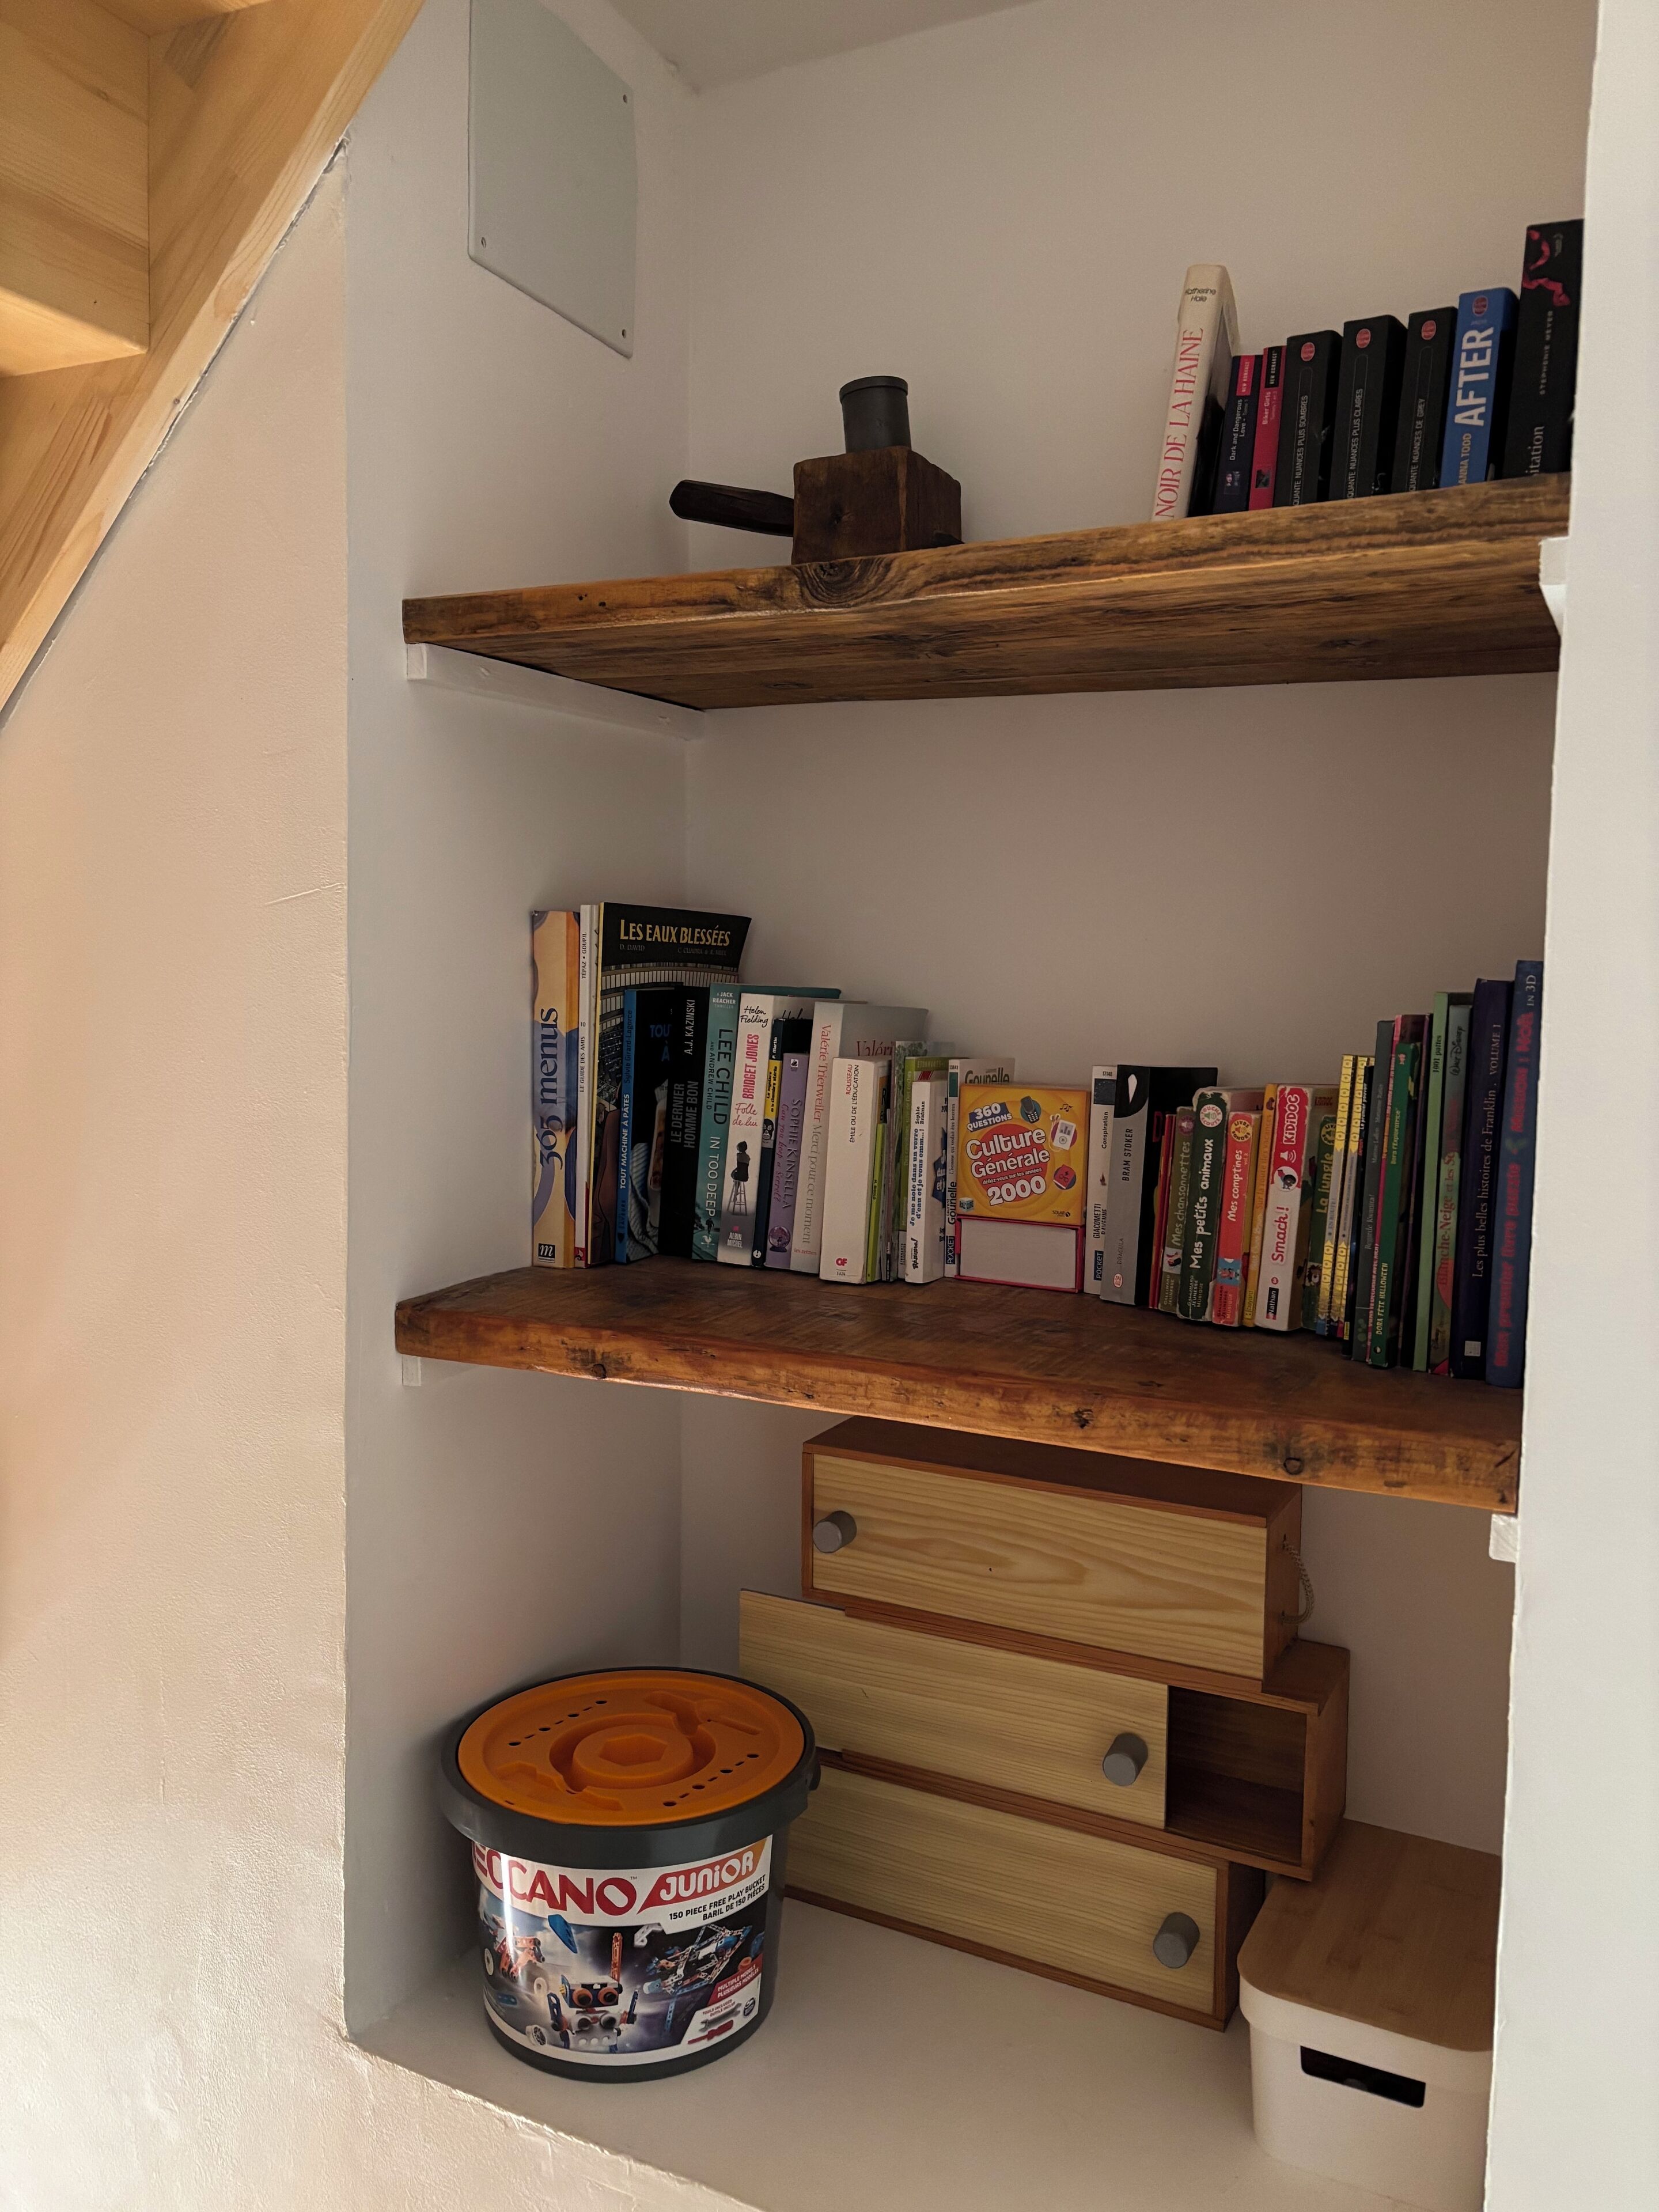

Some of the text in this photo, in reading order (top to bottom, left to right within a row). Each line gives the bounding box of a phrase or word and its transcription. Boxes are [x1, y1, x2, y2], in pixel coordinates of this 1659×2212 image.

[1454, 326, 1494, 427] AFTER
[1233, 399, 1243, 432] Dangerous
[1354, 388, 1363, 418] CLAIRES
[1154, 327, 1204, 519] NOIR DE LA HAINE
[1294, 446, 1304, 478] NUANCES
[1299, 395, 1309, 426] SOMBRES
[1353, 418, 1361, 436] PLUS
[1349, 436, 1359, 469] NUANCES
[1458, 432, 1471, 485] ANNA TODD
[619, 918, 732, 948] LES EAUX BLESSÉES
[712, 997, 736, 1005] REACHER
[1525, 974, 1537, 1007] EN 3D
[683, 999, 695, 1055] A.J. KAZINSKI
[740, 1014, 769, 1028] Fielding
[744, 1005, 767, 1016] Helen
[708, 1053, 716, 1085] ANDREW
[713, 1029, 733, 1125] LEE CHILD
[742, 1033, 760, 1100] BRIDGET JONES
[813, 1024, 831, 1122] Valérie Trierweiler
[536, 1007, 563, 1171] 365 menus
[706, 1088, 714, 1110] CHILD
[851, 1065, 859, 1105] L'ÉDUCATION
[622, 1093, 630, 1119] PÂTES
[670, 1082, 685, 1143] LE DERNIER
[684, 1080, 699, 1149] HOMME BON
[732, 1115, 758, 1127] de lui
[736, 1103, 757, 1115] Folle
[851, 1106, 857, 1115] DE
[851, 1115, 857, 1126] OU
[967, 1112, 1013, 1132] QUESTIONS
[974, 1101, 1002, 1120] 360
[620, 1127, 628, 1169] MACHINE
[782, 1098, 802, 1209] SOPHIE KINSELLA
[965, 1128, 1047, 1161] Culture
[1122, 1128, 1133, 1181] BRAM STOKER
[1472, 1035, 1501, 1278] Les plus belles histoires de Franklin VOLUME
[706, 1136, 721, 1217] IN TOO DEEP
[971, 1147, 1051, 1179] Générale
[1025, 1166, 1043, 1176] années
[1317, 1152, 1334, 1195] jungle
[802, 1124, 822, 1244] Merci pour ce moment
[986, 1175, 1047, 1206] 2000
[1174, 1141, 1191, 1220] chansonnettes
[1227, 1149, 1243, 1222] Mes comptines
[948, 1181, 957, 1225] Gounelle
[1189, 1138, 1214, 1269] Mes petits animaux
[1316, 1198, 1328, 1214] La
[729, 1231, 743, 1241] ALBIN
[1093, 1203, 1101, 1238] GIACOMETTI
[1171, 1221, 1183, 1247] Mes
[1437, 1167, 1456, 1286] Blanche-Neige et les
[727, 1238, 743, 1248] MICHEL
[1096, 1252, 1104, 1279] POCKET
[1267, 1290, 1277, 1315] Nathan
[1375, 1262, 1388, 1335] DORA FÊTE HALLOWEEN
[669, 1874, 766, 1921] 150 PIECE FREE PLAY BUCKET
[702, 1883, 766, 1921] BARIL DE 150 PIÈCES
[717, 1975, 741, 1992] MULTIPLE
